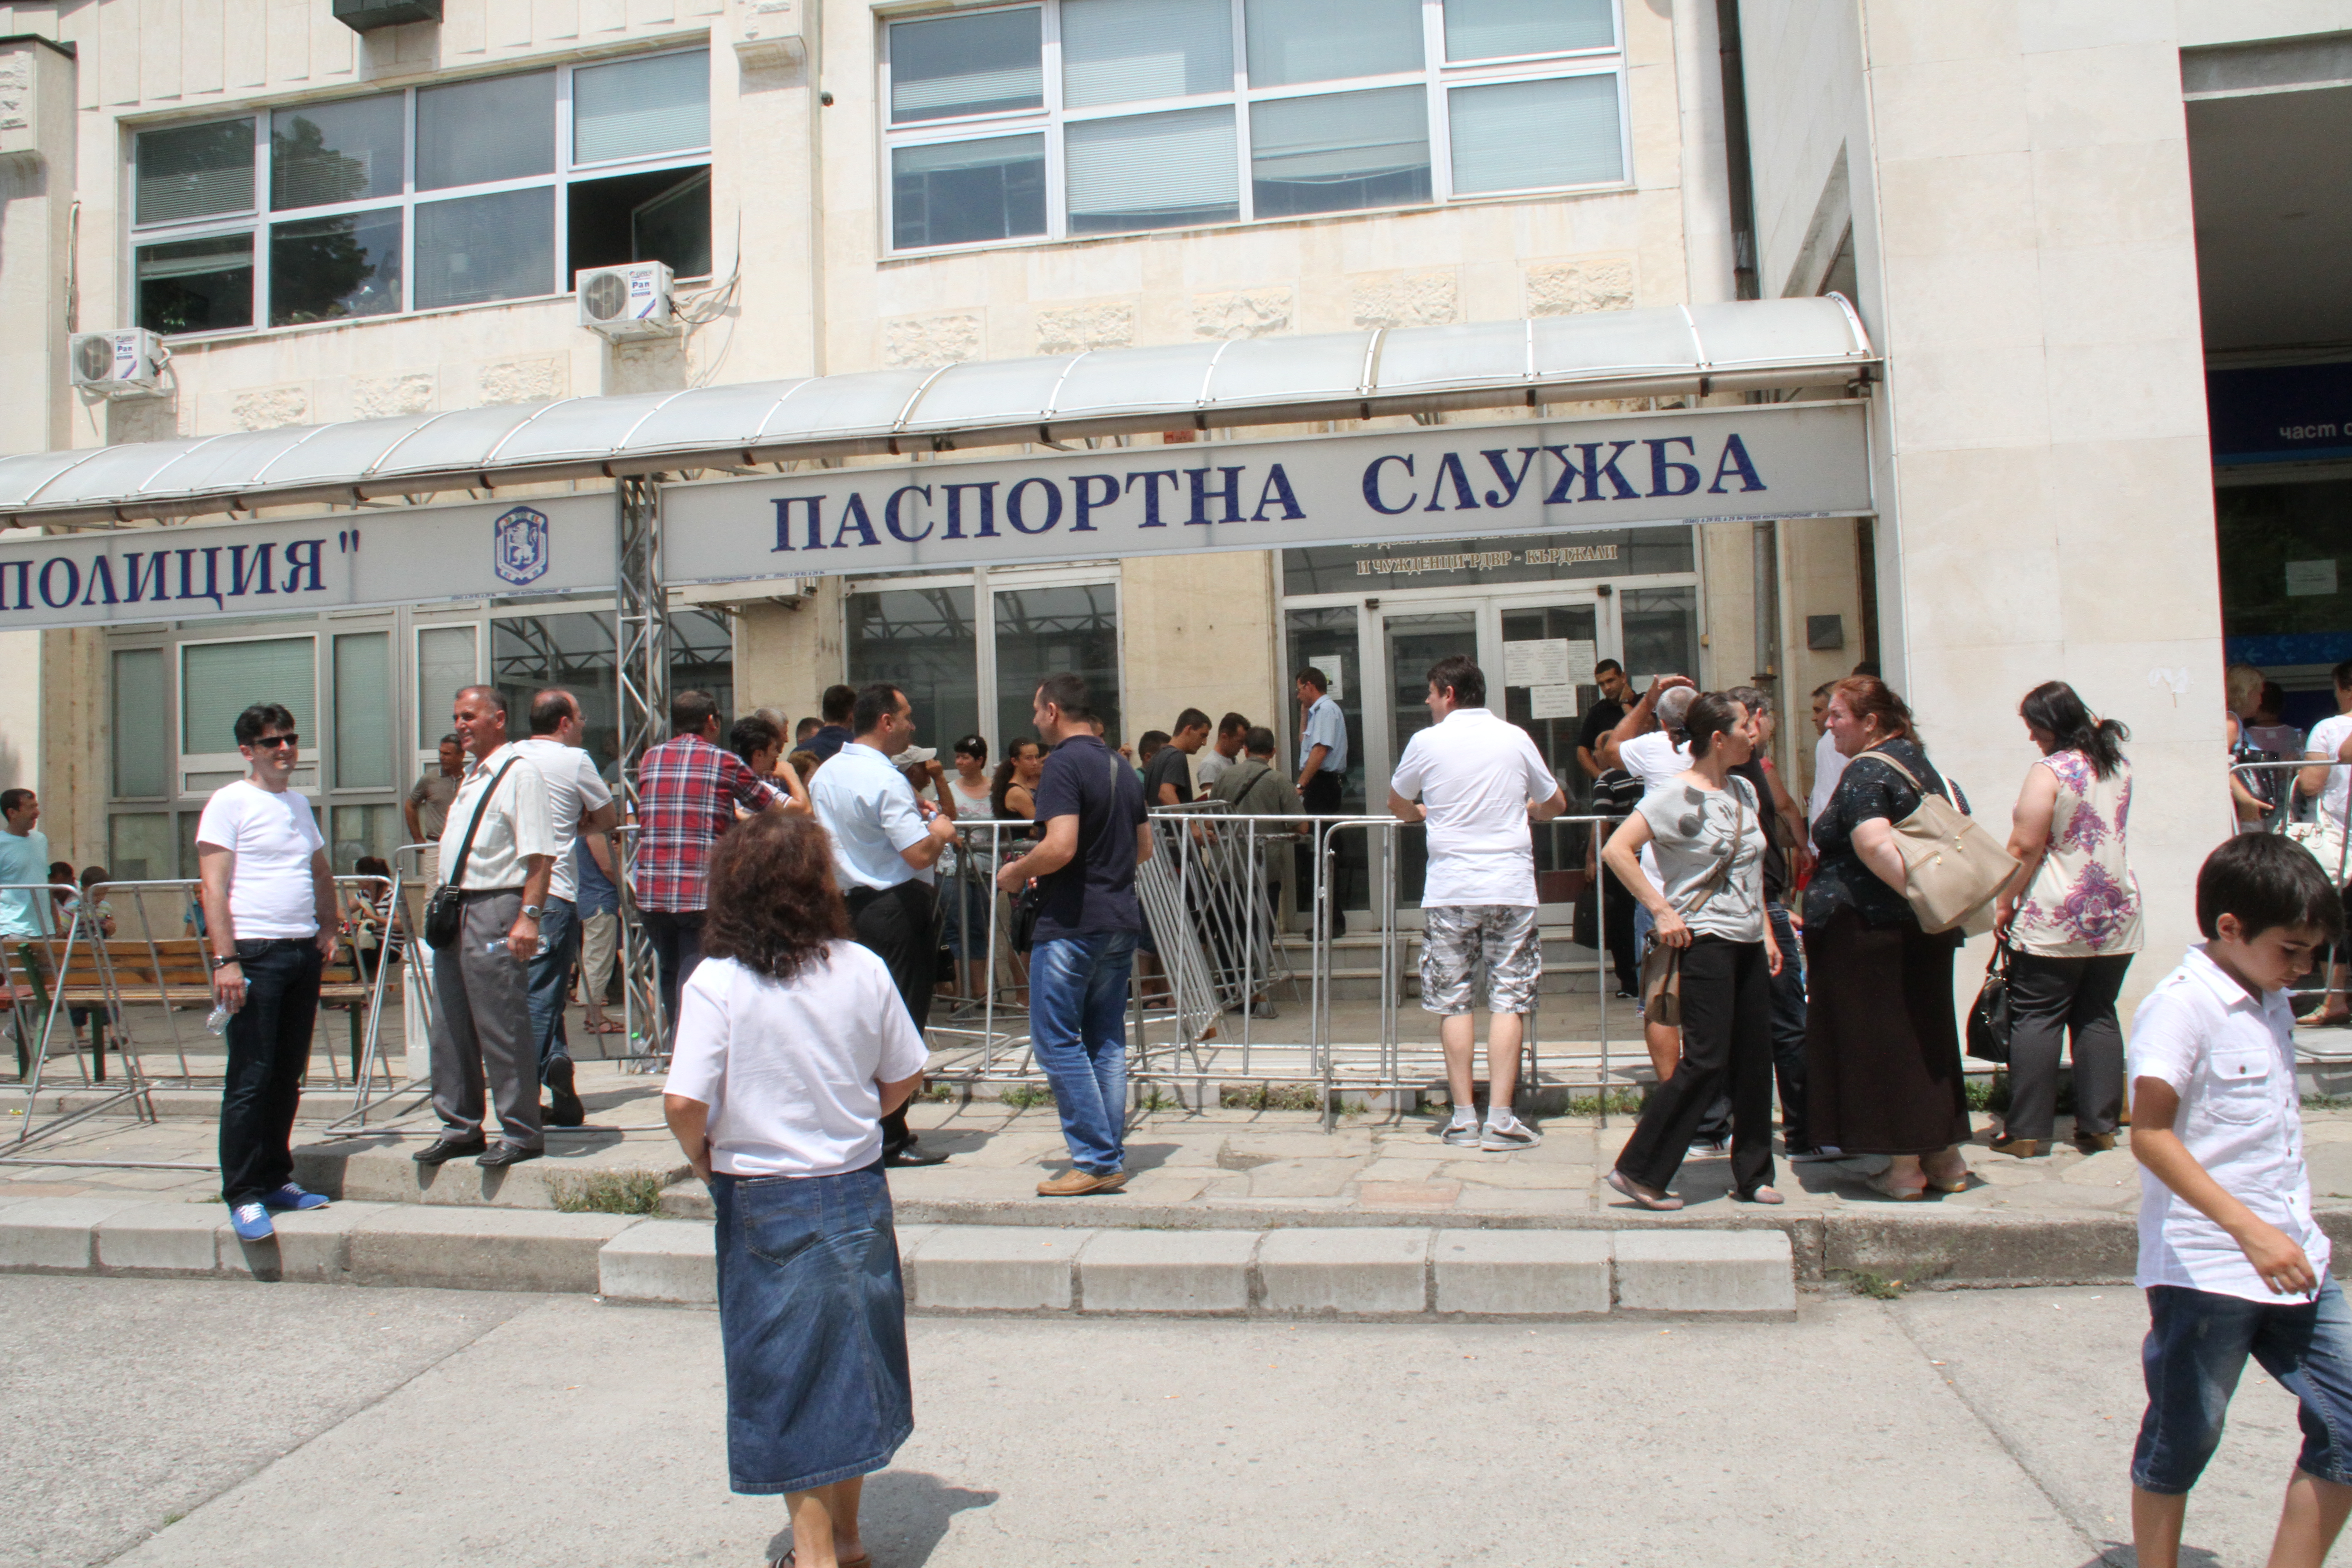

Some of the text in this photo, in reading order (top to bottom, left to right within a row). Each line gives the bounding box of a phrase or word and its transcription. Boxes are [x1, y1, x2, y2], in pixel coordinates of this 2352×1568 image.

[2279, 423, 2337, 440] част
[769, 432, 1769, 554] ПАСПОРТНА СЛУЖБА
[1357, 560, 1371, 575] И
[1525, 544, 1618, 566] КЪРДЖАЛИ
